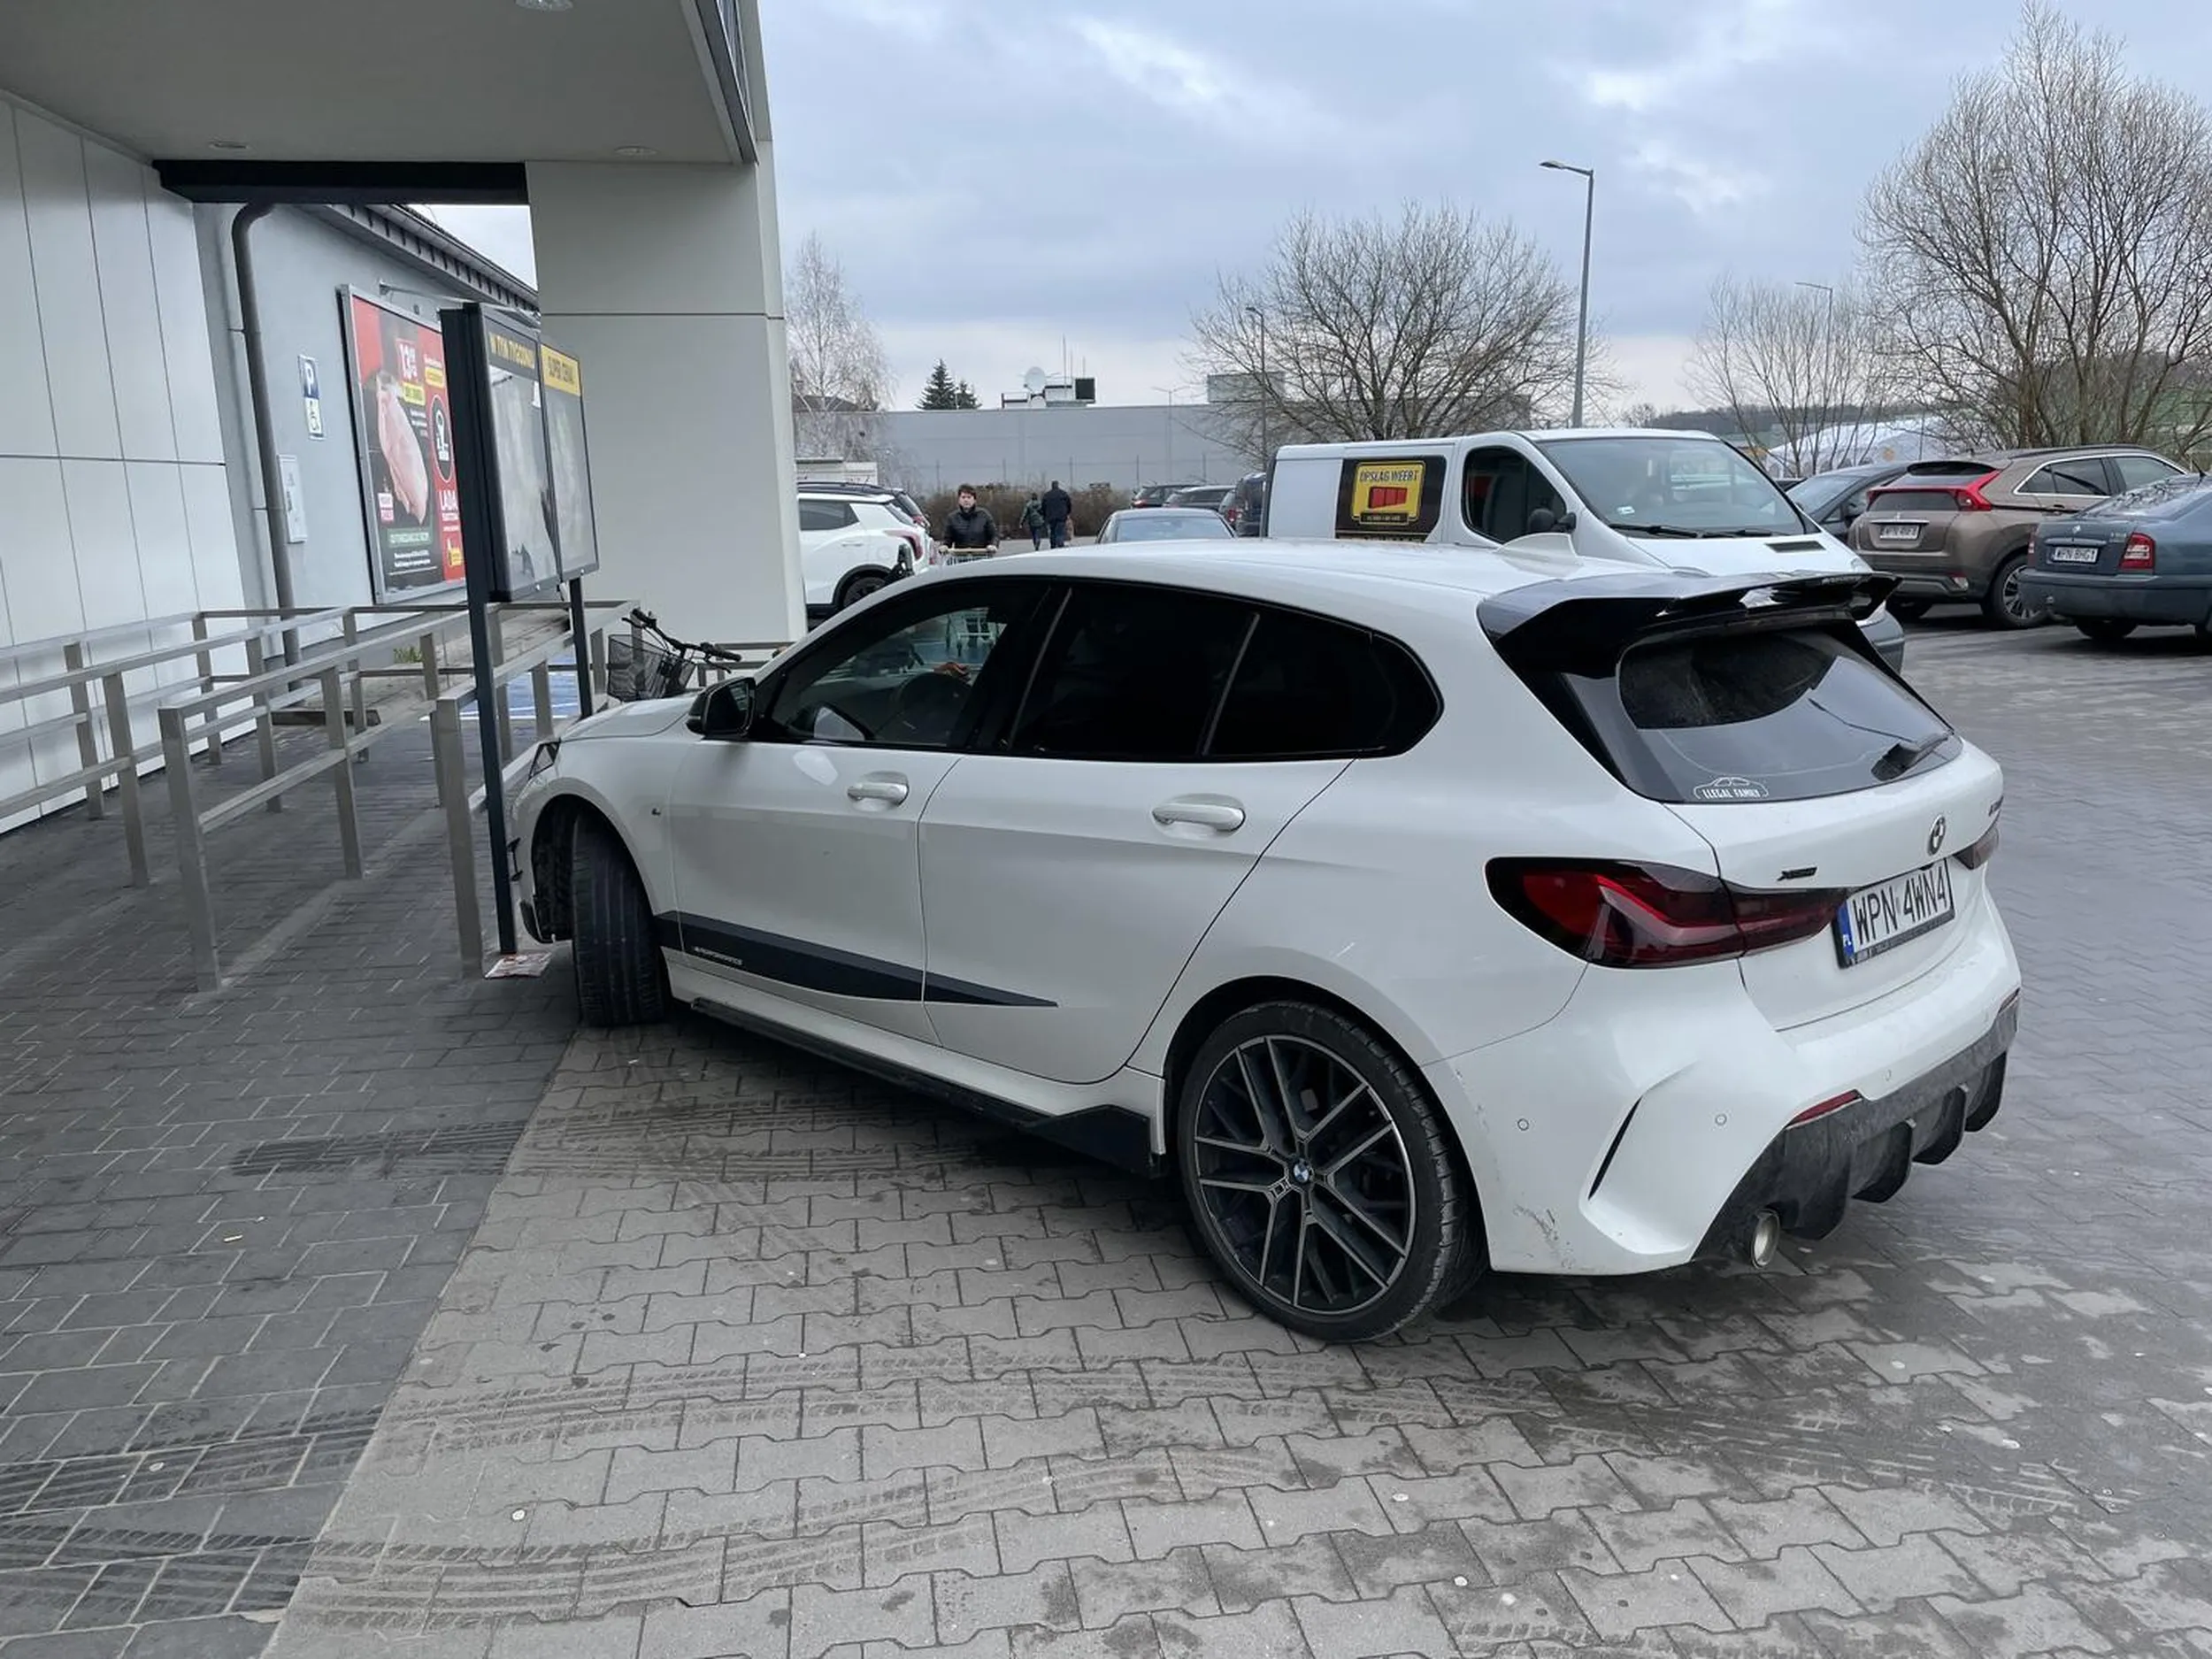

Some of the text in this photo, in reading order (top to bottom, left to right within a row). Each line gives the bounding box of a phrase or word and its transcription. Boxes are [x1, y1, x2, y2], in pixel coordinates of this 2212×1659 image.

[1391, 469, 1417, 481] WEERT
[1853, 886, 1899, 946] WPN
[1902, 865, 1948, 924] 4WN4
